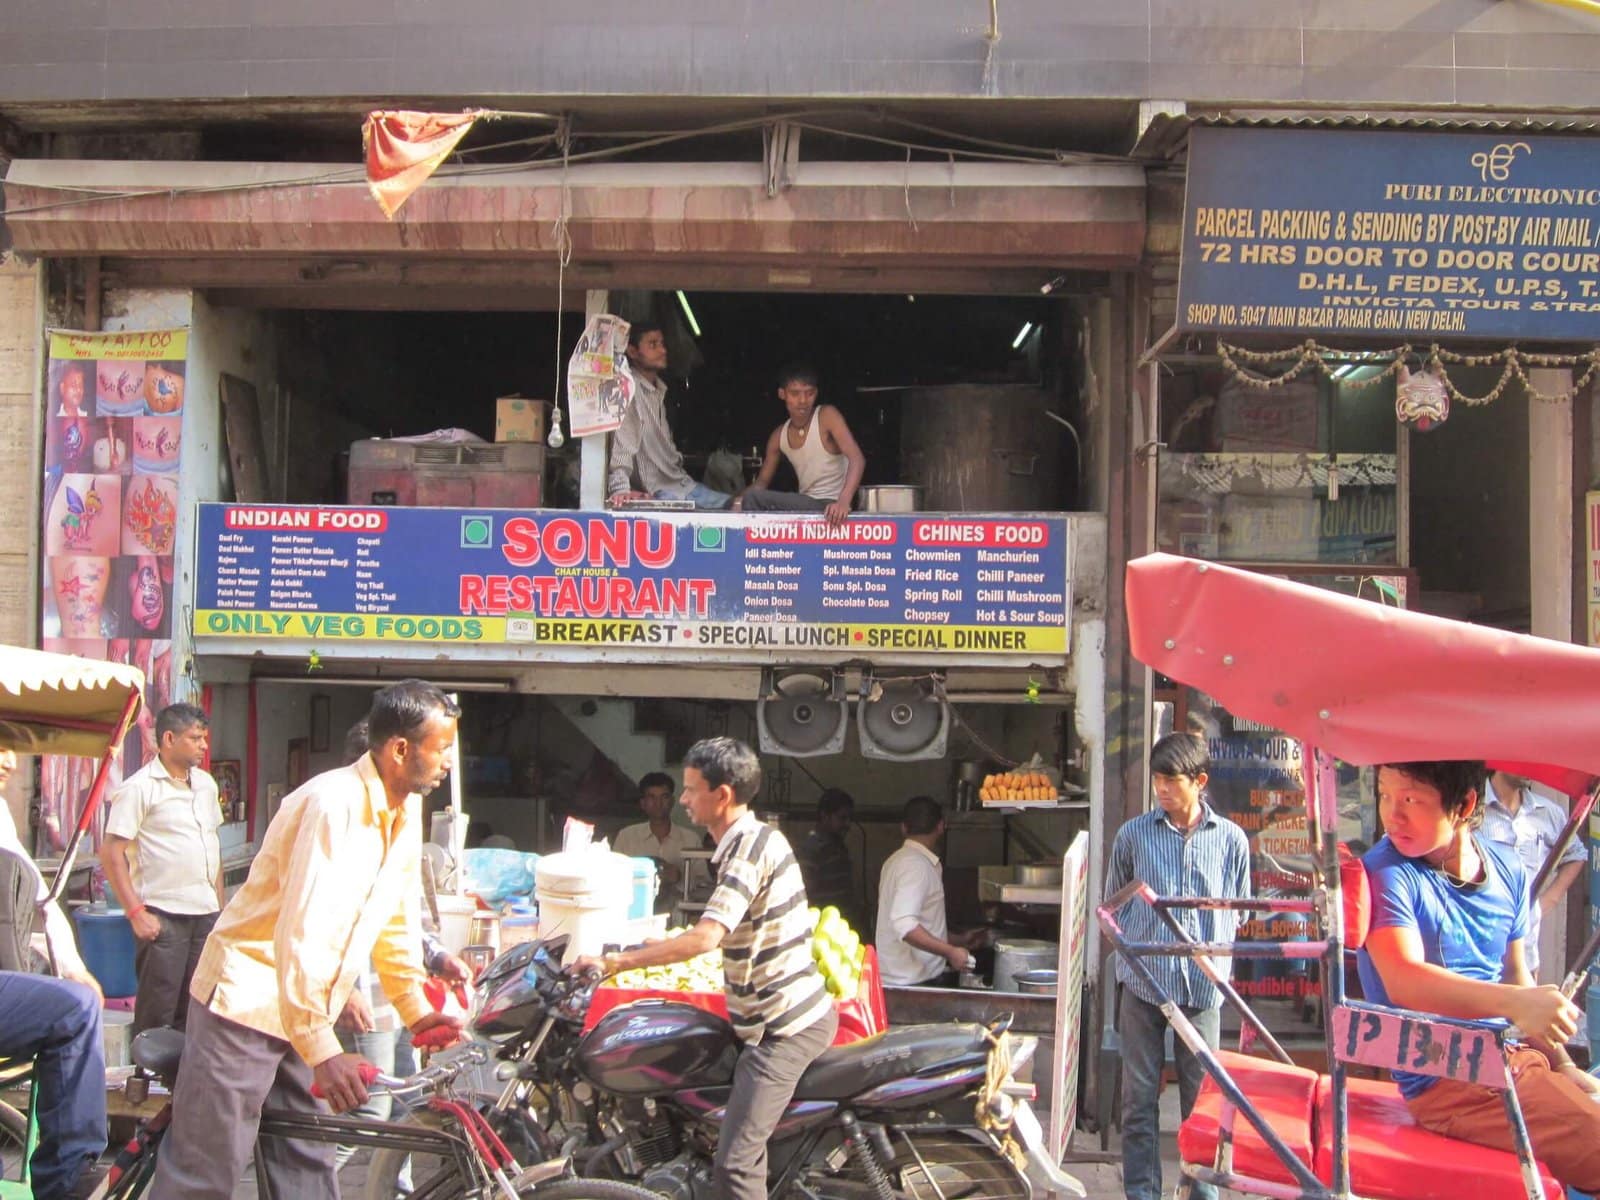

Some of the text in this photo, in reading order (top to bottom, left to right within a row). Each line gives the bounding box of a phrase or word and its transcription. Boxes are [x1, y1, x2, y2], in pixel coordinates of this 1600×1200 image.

[1384, 183, 1600, 206] PURI ELECTRONIC
[1195, 207, 1256, 238] PARCEL
[1260, 209, 1331, 240] PACKING
[1334, 211, 1347, 241] &
[1351, 211, 1423, 242] SENDING
[1425, 213, 1450, 243] BY
[1451, 214, 1522, 245] POST-BY
[1521, 216, 1551, 246] AIR
[1553, 217, 1592, 248] MAIL
[1200, 243, 1232, 263] 72
[1240, 244, 1297, 265] HRS
[1305, 246, 1384, 266] DOOR
[1392, 248, 1428, 268] TO
[1436, 249, 1514, 270] DOOR
[1299, 273, 1378, 294] D.H.L,
[1387, 275, 1485, 297] FEDEX,
[1495, 278, 1568, 299] U.P.S,
[1323, 296, 1436, 308] INVICTA
[1444, 299, 1520, 311] TOUR
[1187, 303, 1466, 331] SHOP NO. 5047 MAIN BAZAR PAHAR GANJ NEW DELHI.
[229, 509, 381, 529] INDIAN FOOD
[750, 523, 892, 540] SOUTH INDIAN FOOD
[919, 524, 1043, 543] CHINES FOOD
[502, 517, 677, 569] SONU
[745, 548, 759, 559] Idli
[823, 549, 892, 560] Mushroom Dosa
[905, 549, 961, 561] Chowmien
[977, 550, 1039, 563] Manchurien
[554, 567, 582, 577] CHAAT
[582, 567, 611, 577] HOUSE
[744, 564, 767, 575] Vada
[823, 565, 896, 577] Spl. Masala Dosa
[905, 569, 959, 582] Fried Rice
[976, 569, 1045, 583] Chilli Paneer
[744, 580, 799, 590] Masala Dosa
[822, 581, 844, 591] Sonu
[865, 582, 887, 591] Dosa
[459, 574, 716, 618] RESTAURANT
[744, 596, 793, 607] Onion Dosa
[822, 597, 889, 608] Chocolate Dosa
[904, 588, 962, 603] Spring Roll
[976, 589, 1062, 603] Chilli Mushroom
[776, 613, 797, 623] Dosa
[904, 608, 950, 623] Chopsey
[976, 609, 1065, 625] Hot & Sour Soup
[208, 612, 483, 640] ONLY VEG FOODS
[535, 622, 1027, 649] BREAKFAST SPECIAL LUNCH SPECIAL DINNER
[1263, 837, 1312, 855] TICKETIN
